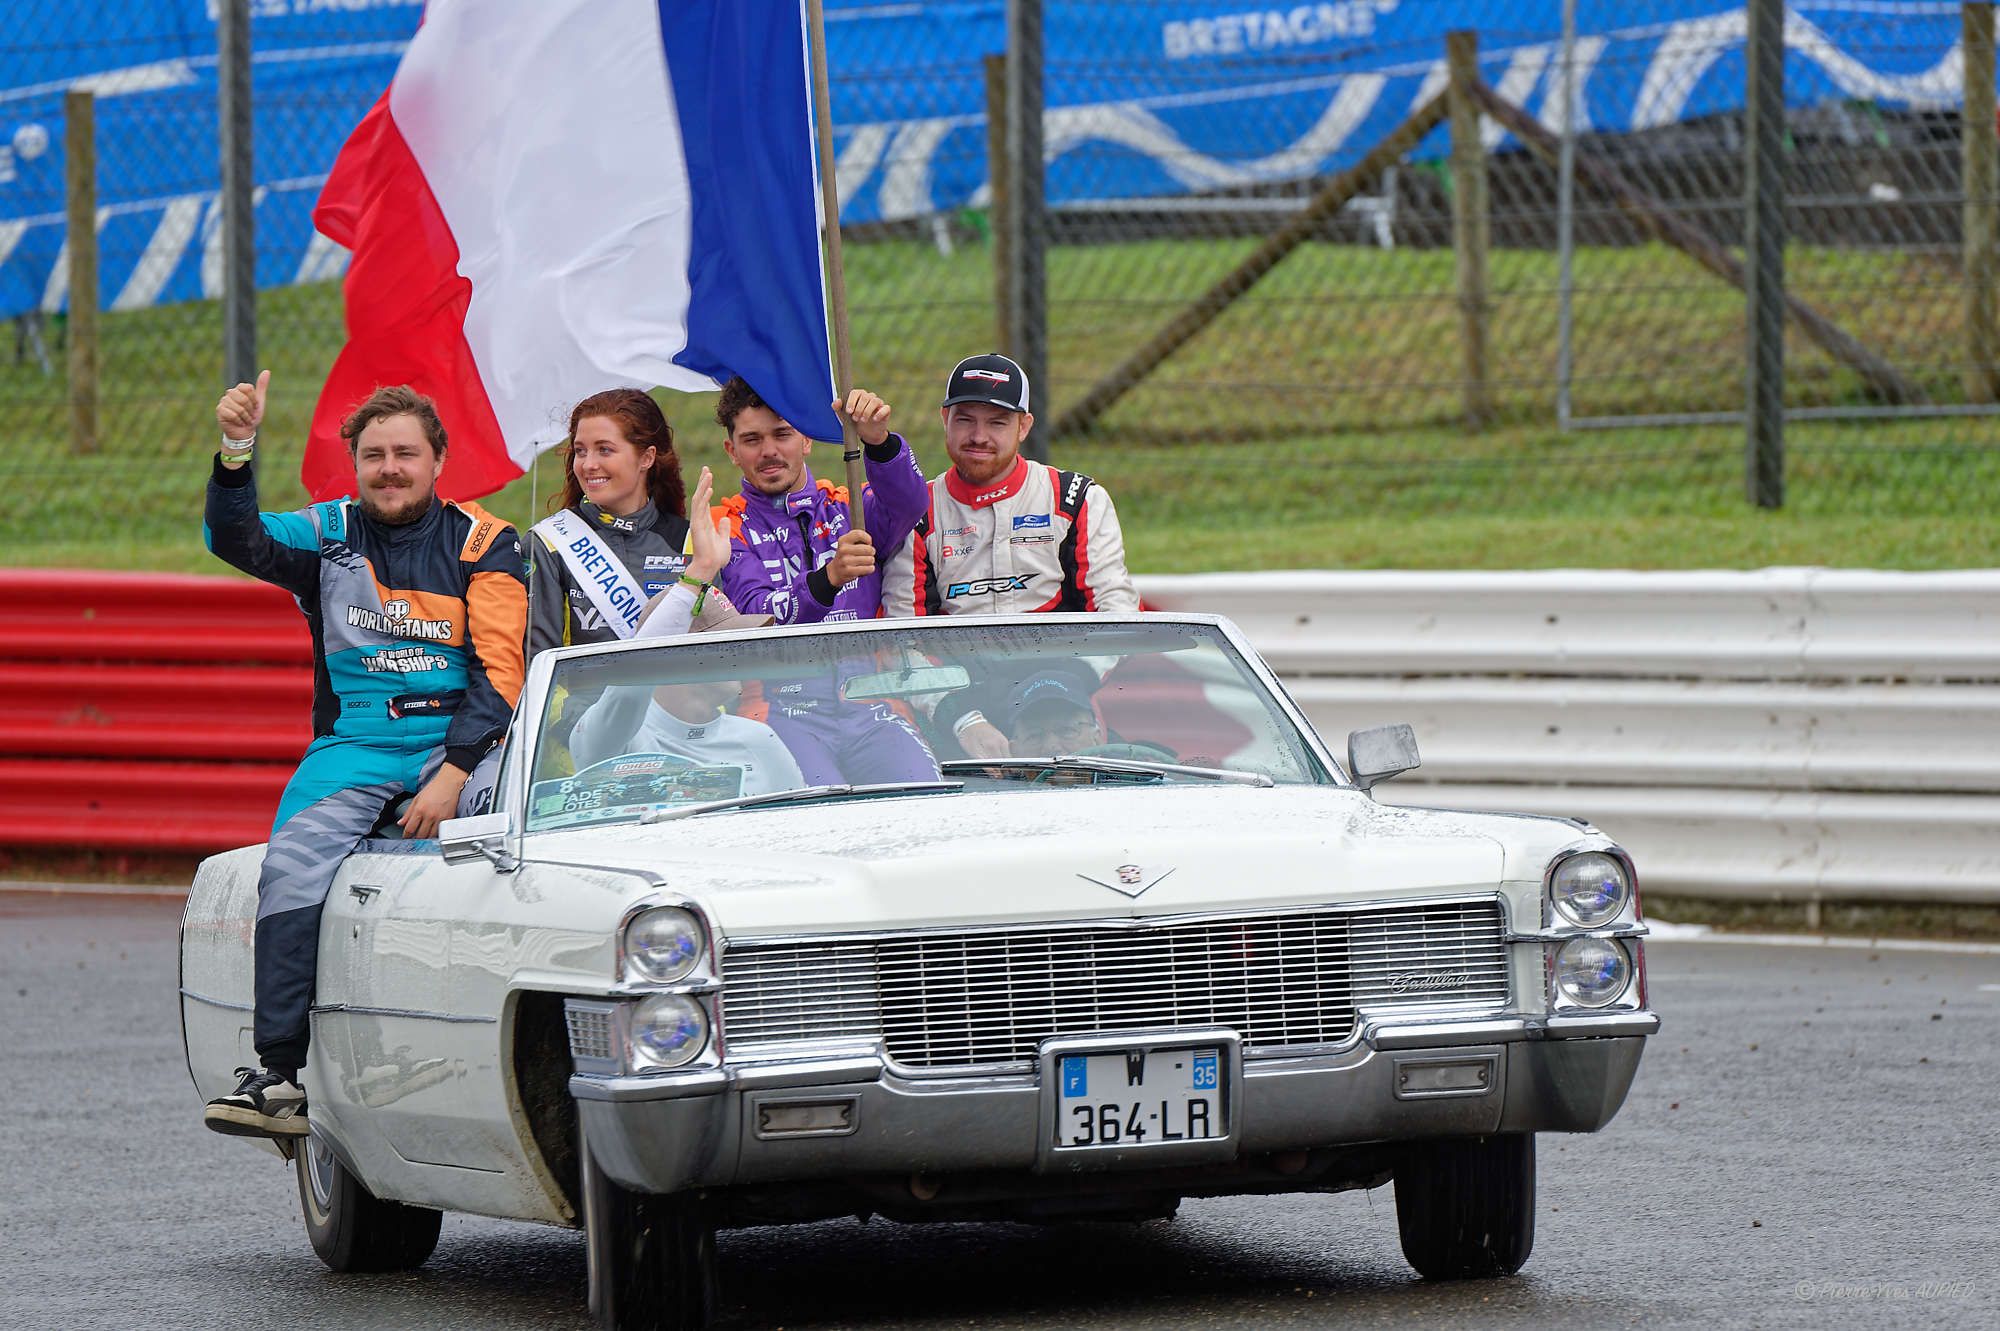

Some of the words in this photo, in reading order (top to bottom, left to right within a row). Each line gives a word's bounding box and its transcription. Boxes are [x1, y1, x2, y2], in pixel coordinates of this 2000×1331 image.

[1163, 1, 1376, 59] BRETAGNE
[470, 521, 493, 554] sparco
[569, 536, 643, 630] BRETAGNE
[347, 605, 393, 634] WORLD
[392, 623, 406, 637] OF
[403, 618, 453, 640] TANKS
[360, 655, 449, 673] WARSHIPS
[387, 649, 414, 659] WORLD
[414, 646, 425, 657] OF
[1386, 969, 1470, 994] Cadillac
[1071, 1078, 1080, 1089] F
[1194, 1066, 1216, 1086] 35
